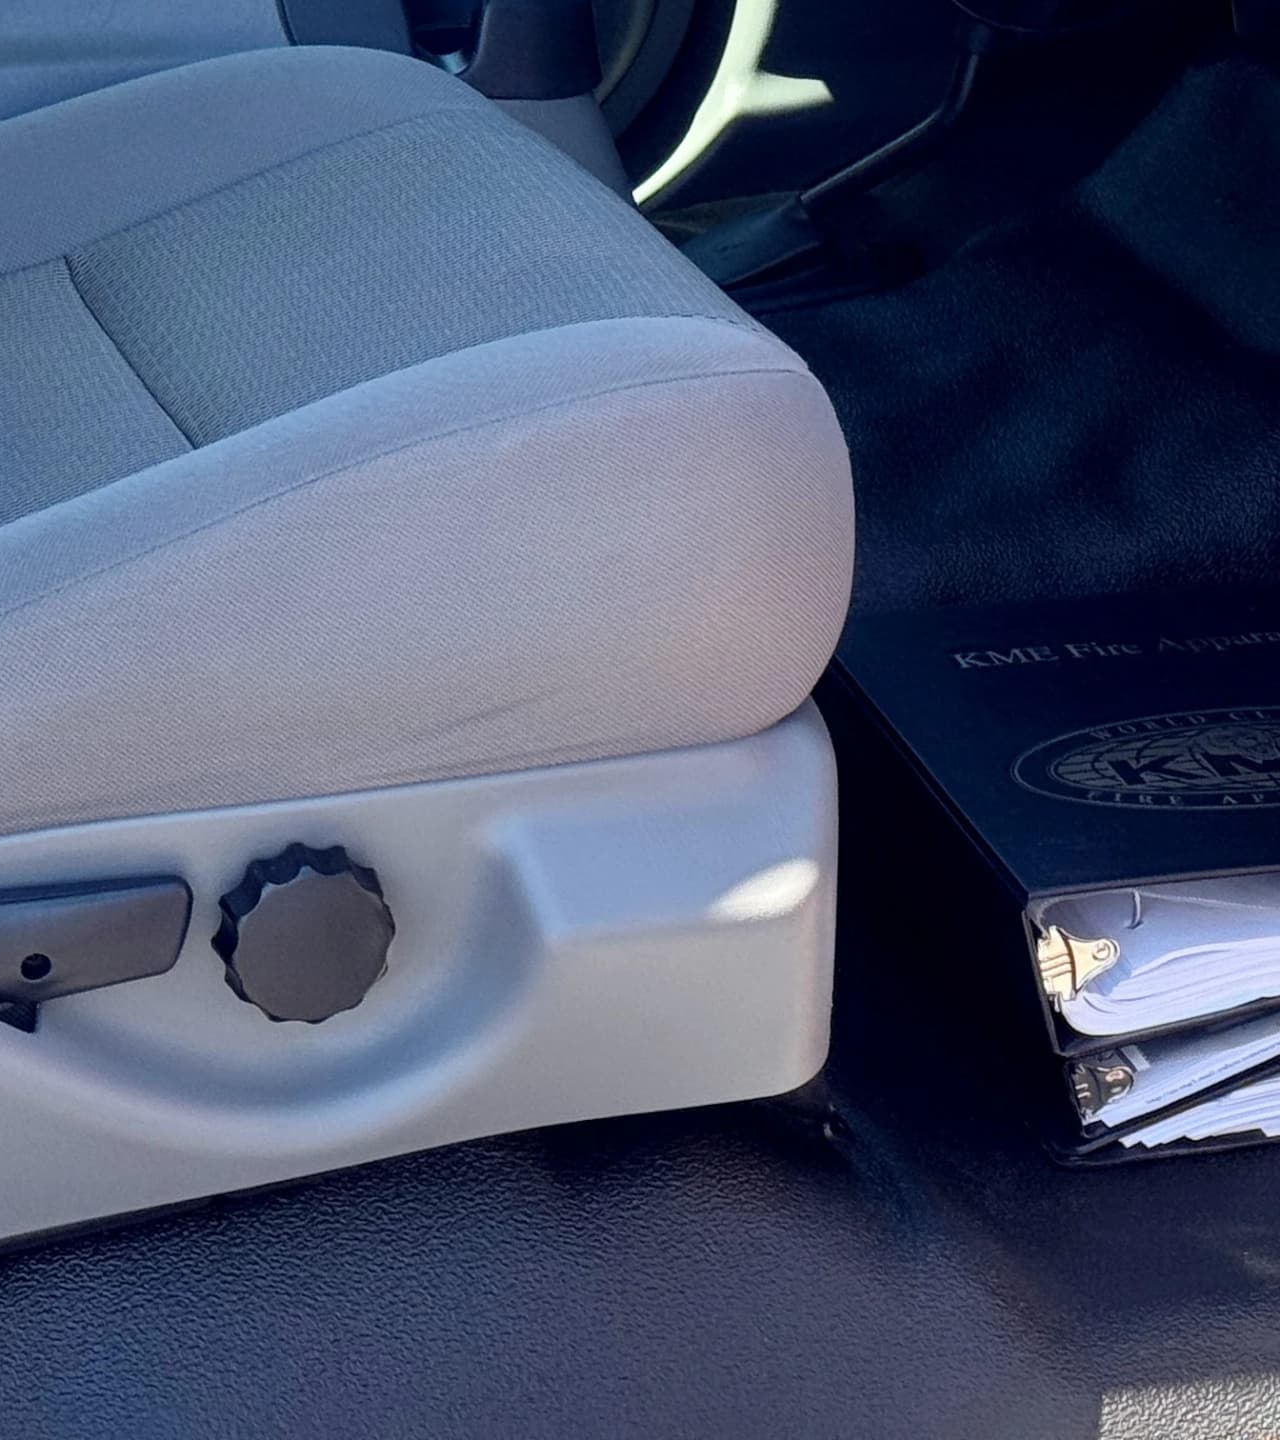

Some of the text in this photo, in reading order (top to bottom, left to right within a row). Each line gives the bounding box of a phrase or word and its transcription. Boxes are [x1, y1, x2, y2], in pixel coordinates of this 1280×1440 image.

[953, 645, 1060, 669] KME
[1064, 641, 1144, 659] Fire
[1089, 715, 1207, 740] WORLD
[1086, 790, 1186, 807] FIRE
